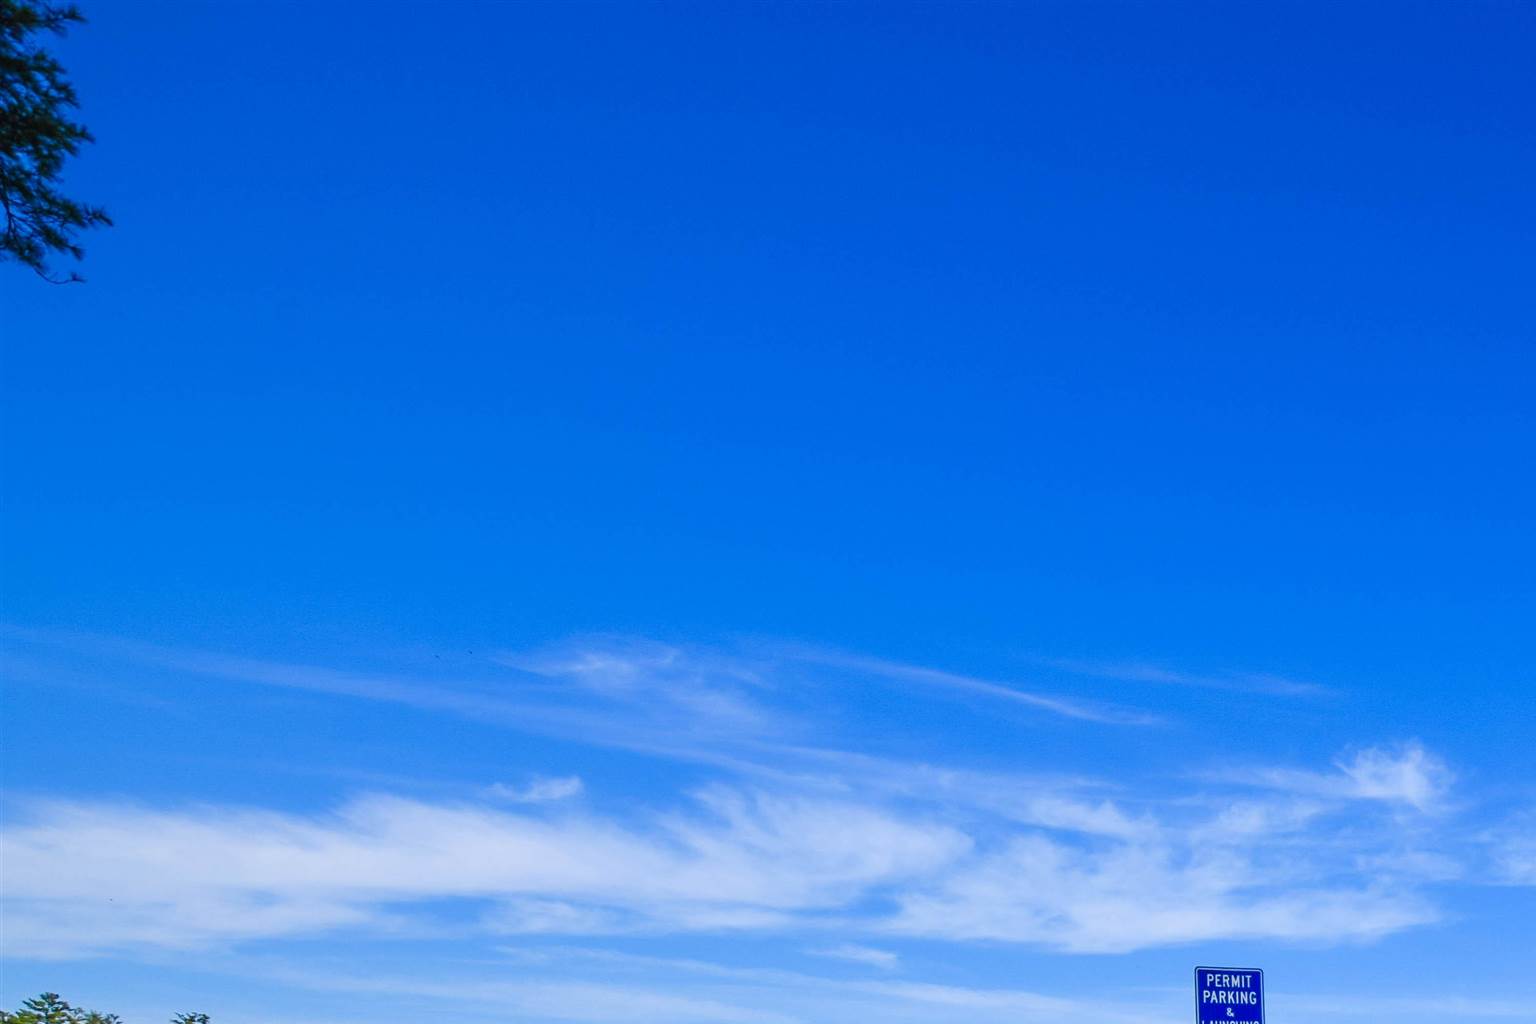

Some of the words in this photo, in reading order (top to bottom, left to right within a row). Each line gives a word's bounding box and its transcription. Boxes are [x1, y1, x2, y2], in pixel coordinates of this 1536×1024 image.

[1206, 974, 1252, 988] PERMIT
[1203, 990, 1257, 1005] PARKING
[1226, 1007, 1235, 1017] &
